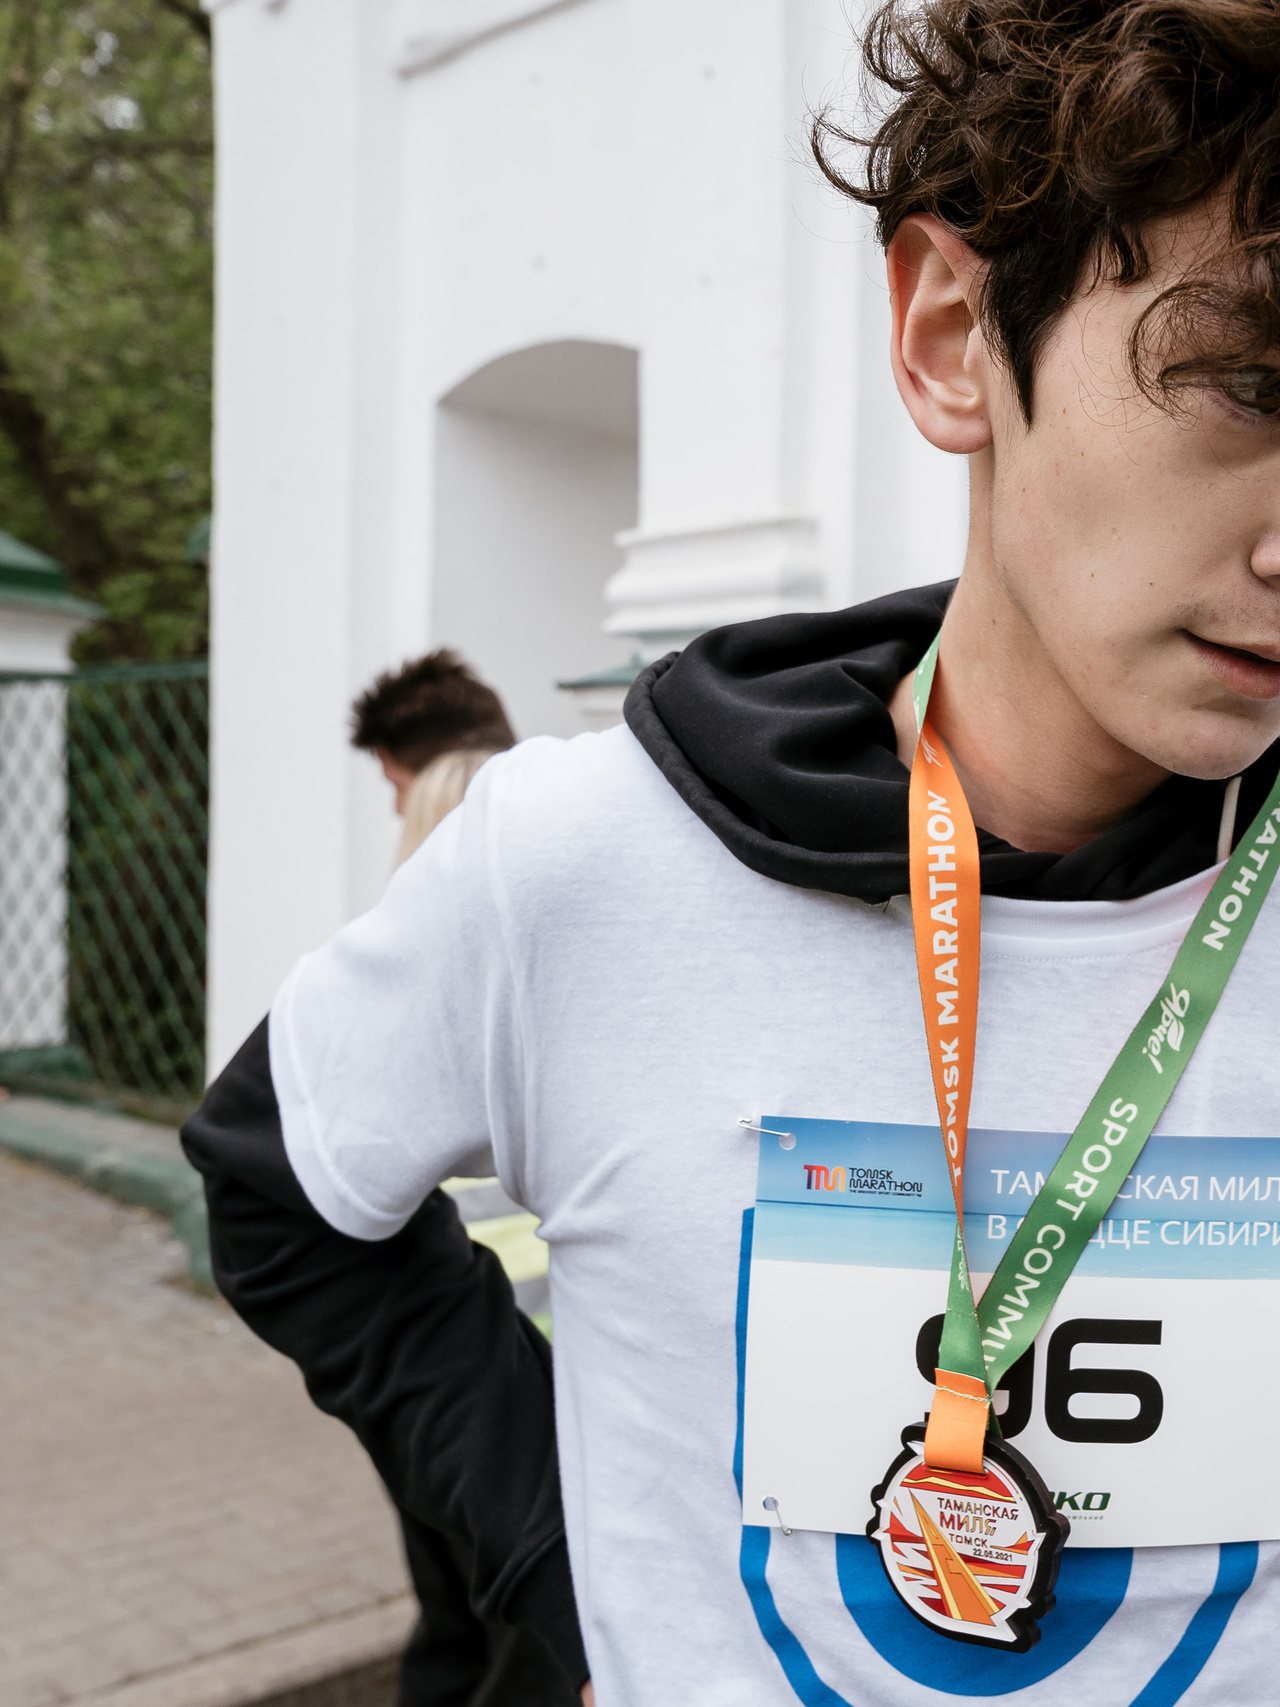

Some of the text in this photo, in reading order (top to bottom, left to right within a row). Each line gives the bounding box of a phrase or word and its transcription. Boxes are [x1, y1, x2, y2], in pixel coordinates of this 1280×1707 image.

[927, 789, 962, 1187] TOMSK MARATHON
[1056, 1097, 1138, 1221] SPORT
[849, 1167, 893, 1180] TOMSK
[849, 1178, 923, 1193] MARATHON
[987, 1214, 1007, 1240] В
[937, 1497, 1019, 1520] ТАМАНСКАЯ
[939, 1511, 997, 1536] МИЛЯ
[949, 1532, 988, 1549] ТОМСК
[973, 1547, 1013, 1562] 22.05.2021
